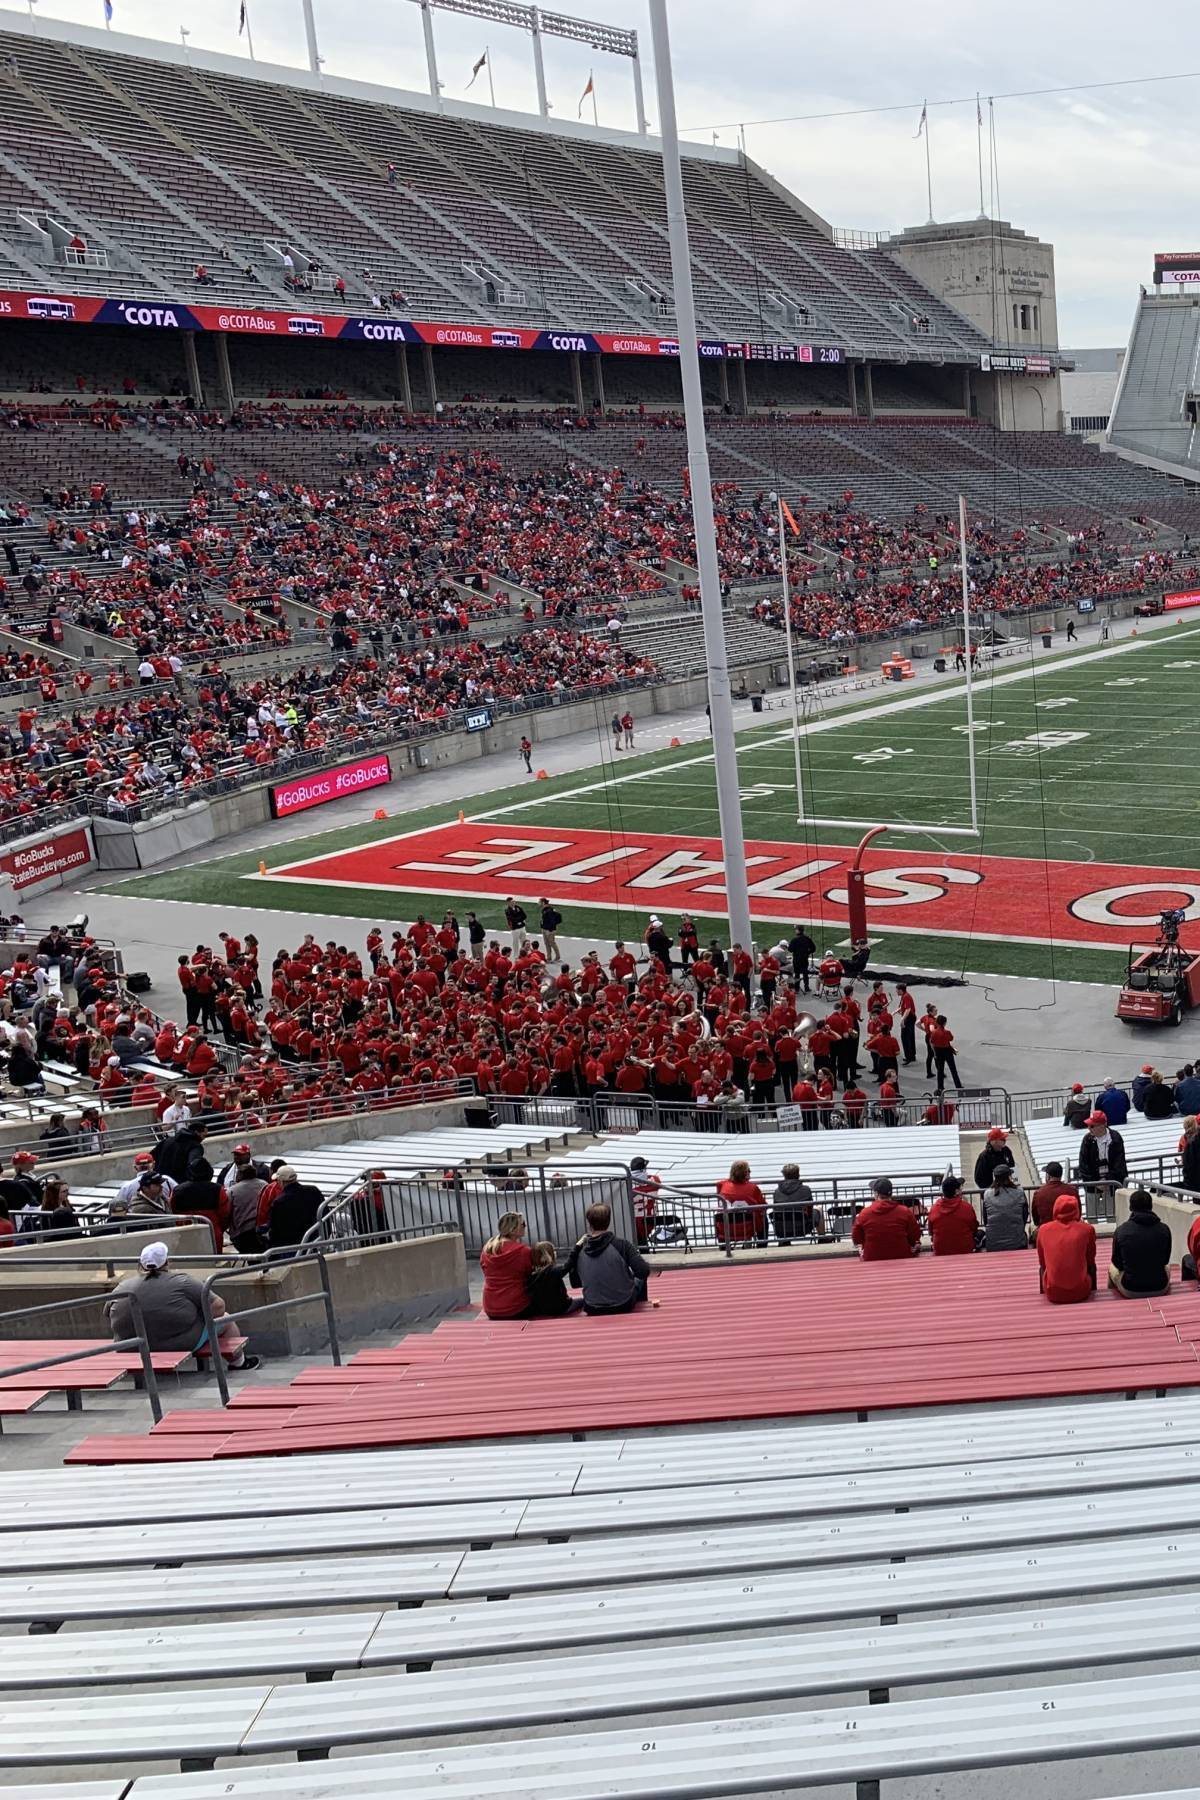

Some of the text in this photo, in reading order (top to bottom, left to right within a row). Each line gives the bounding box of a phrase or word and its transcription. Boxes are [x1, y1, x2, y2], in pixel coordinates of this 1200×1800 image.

[1173, 273, 1200, 281] COTA
[125, 308, 179, 327] COTA
[218, 314, 276, 331] @COTABus
[363, 323, 406, 341] COTA
[436, 330, 483, 345] @COTABus
[551, 336, 587, 351] COTA
[612, 339, 651, 352] @COTABus
[701, 345, 723, 356] COTA
[820, 349, 840, 362] 2:00
[247, 599, 274, 608] CAMBRIA
[851, 746, 914, 762] 20
[13, 845, 55, 868] #GoBucks
[394, 837, 985, 907] STATE
[1042, 1701, 1056, 1711] 12
[846, 1721, 857, 1730] 11
[642, 1741, 656, 1752] 10
